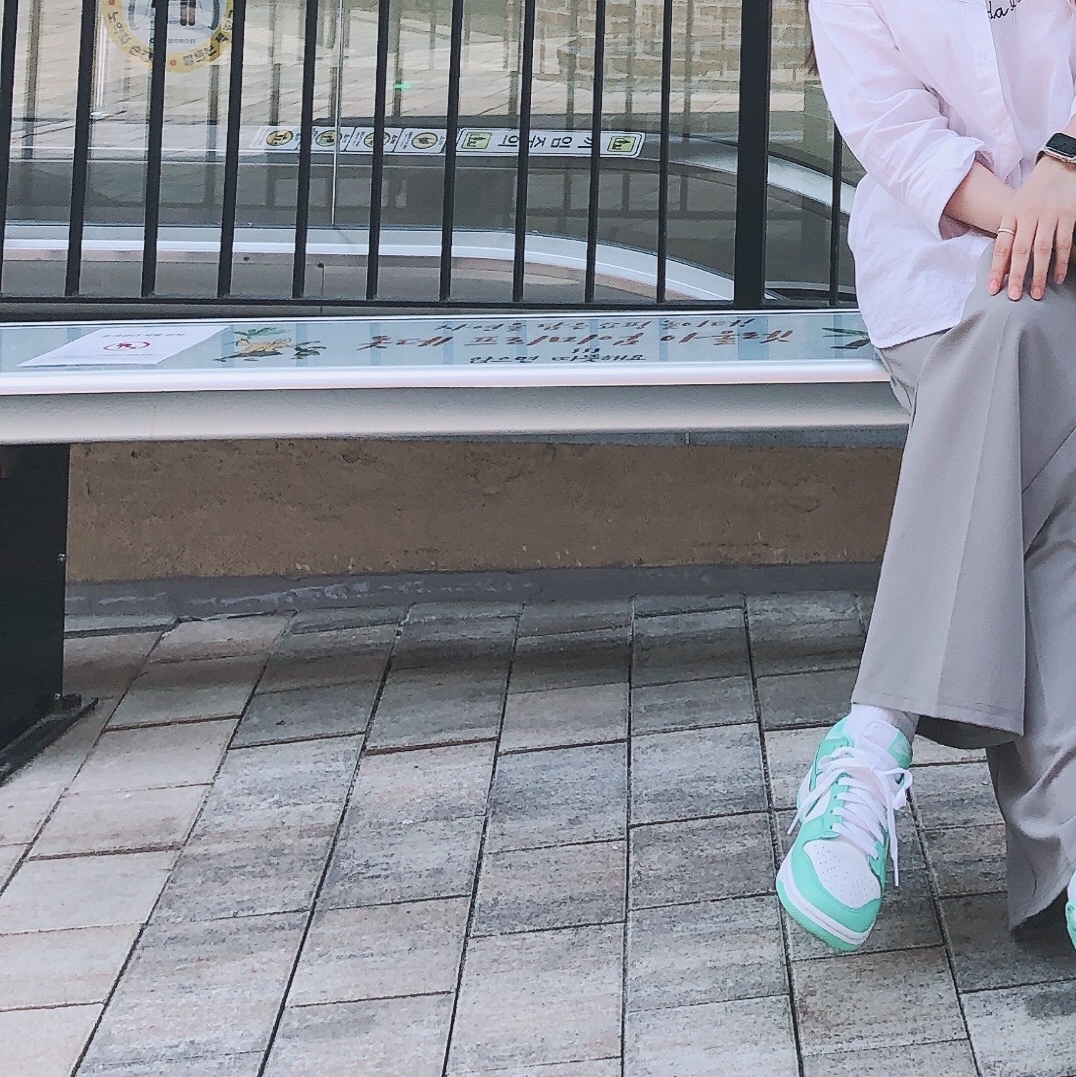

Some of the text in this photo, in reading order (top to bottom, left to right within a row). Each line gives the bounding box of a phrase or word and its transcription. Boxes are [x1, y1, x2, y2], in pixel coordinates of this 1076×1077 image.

[357, 330, 794, 351] 롯데 프리미엄 아울렛
